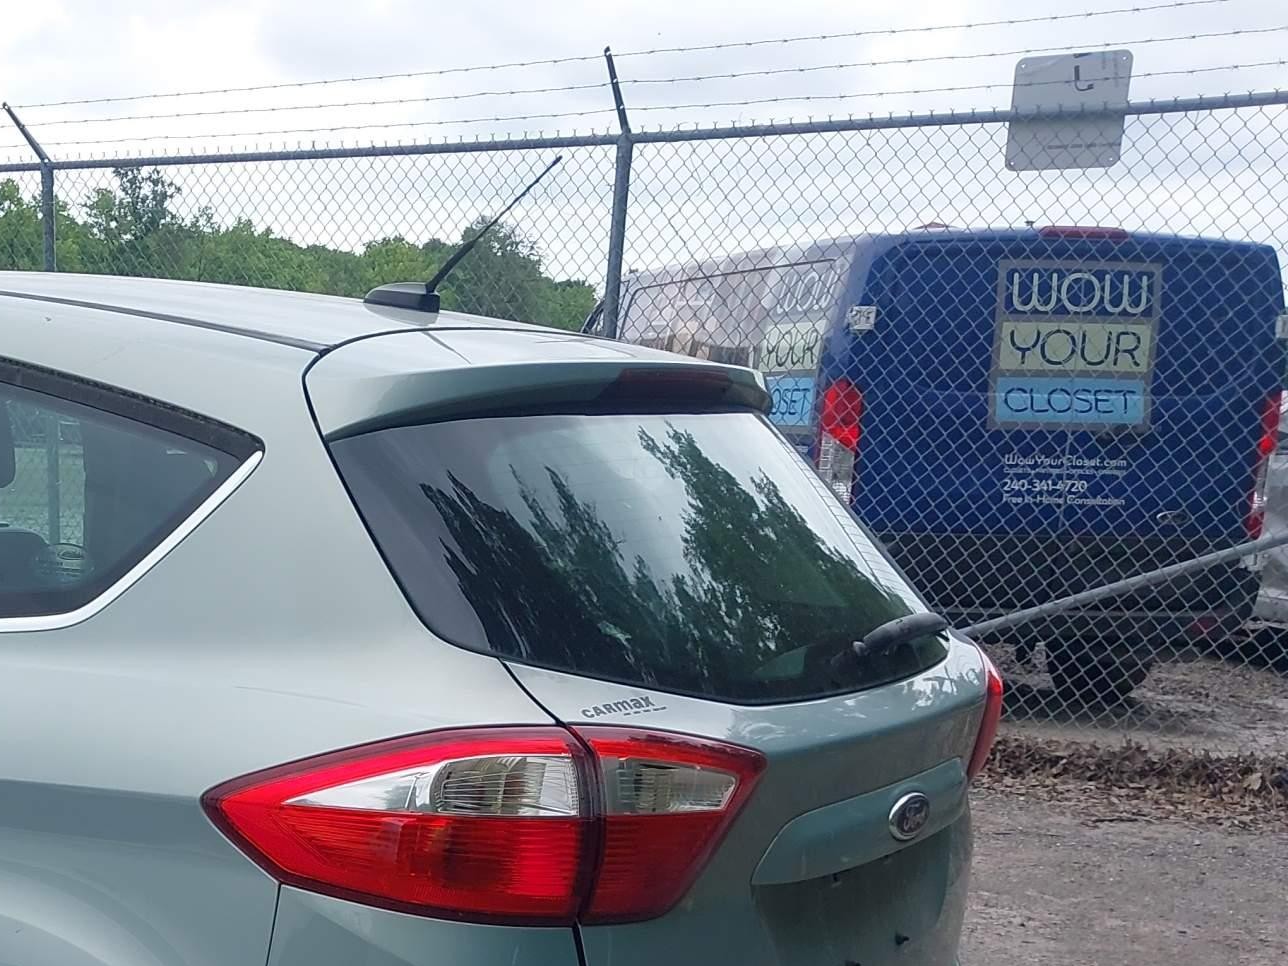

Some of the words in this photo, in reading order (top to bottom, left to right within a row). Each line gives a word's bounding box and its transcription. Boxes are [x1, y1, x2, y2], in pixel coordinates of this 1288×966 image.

[1012, 272, 1148, 314] WOW
[764, 327, 819, 368] YOUR
[1009, 328, 1142, 368] YOUR
[770, 388, 811, 417] OSET
[1003, 387, 1137, 415] CLOSET
[1003, 454, 1127, 467] WowYourCloset.com
[1003, 480, 1088, 492] 240-341-4720
[1003, 494, 1023, 504] Free
